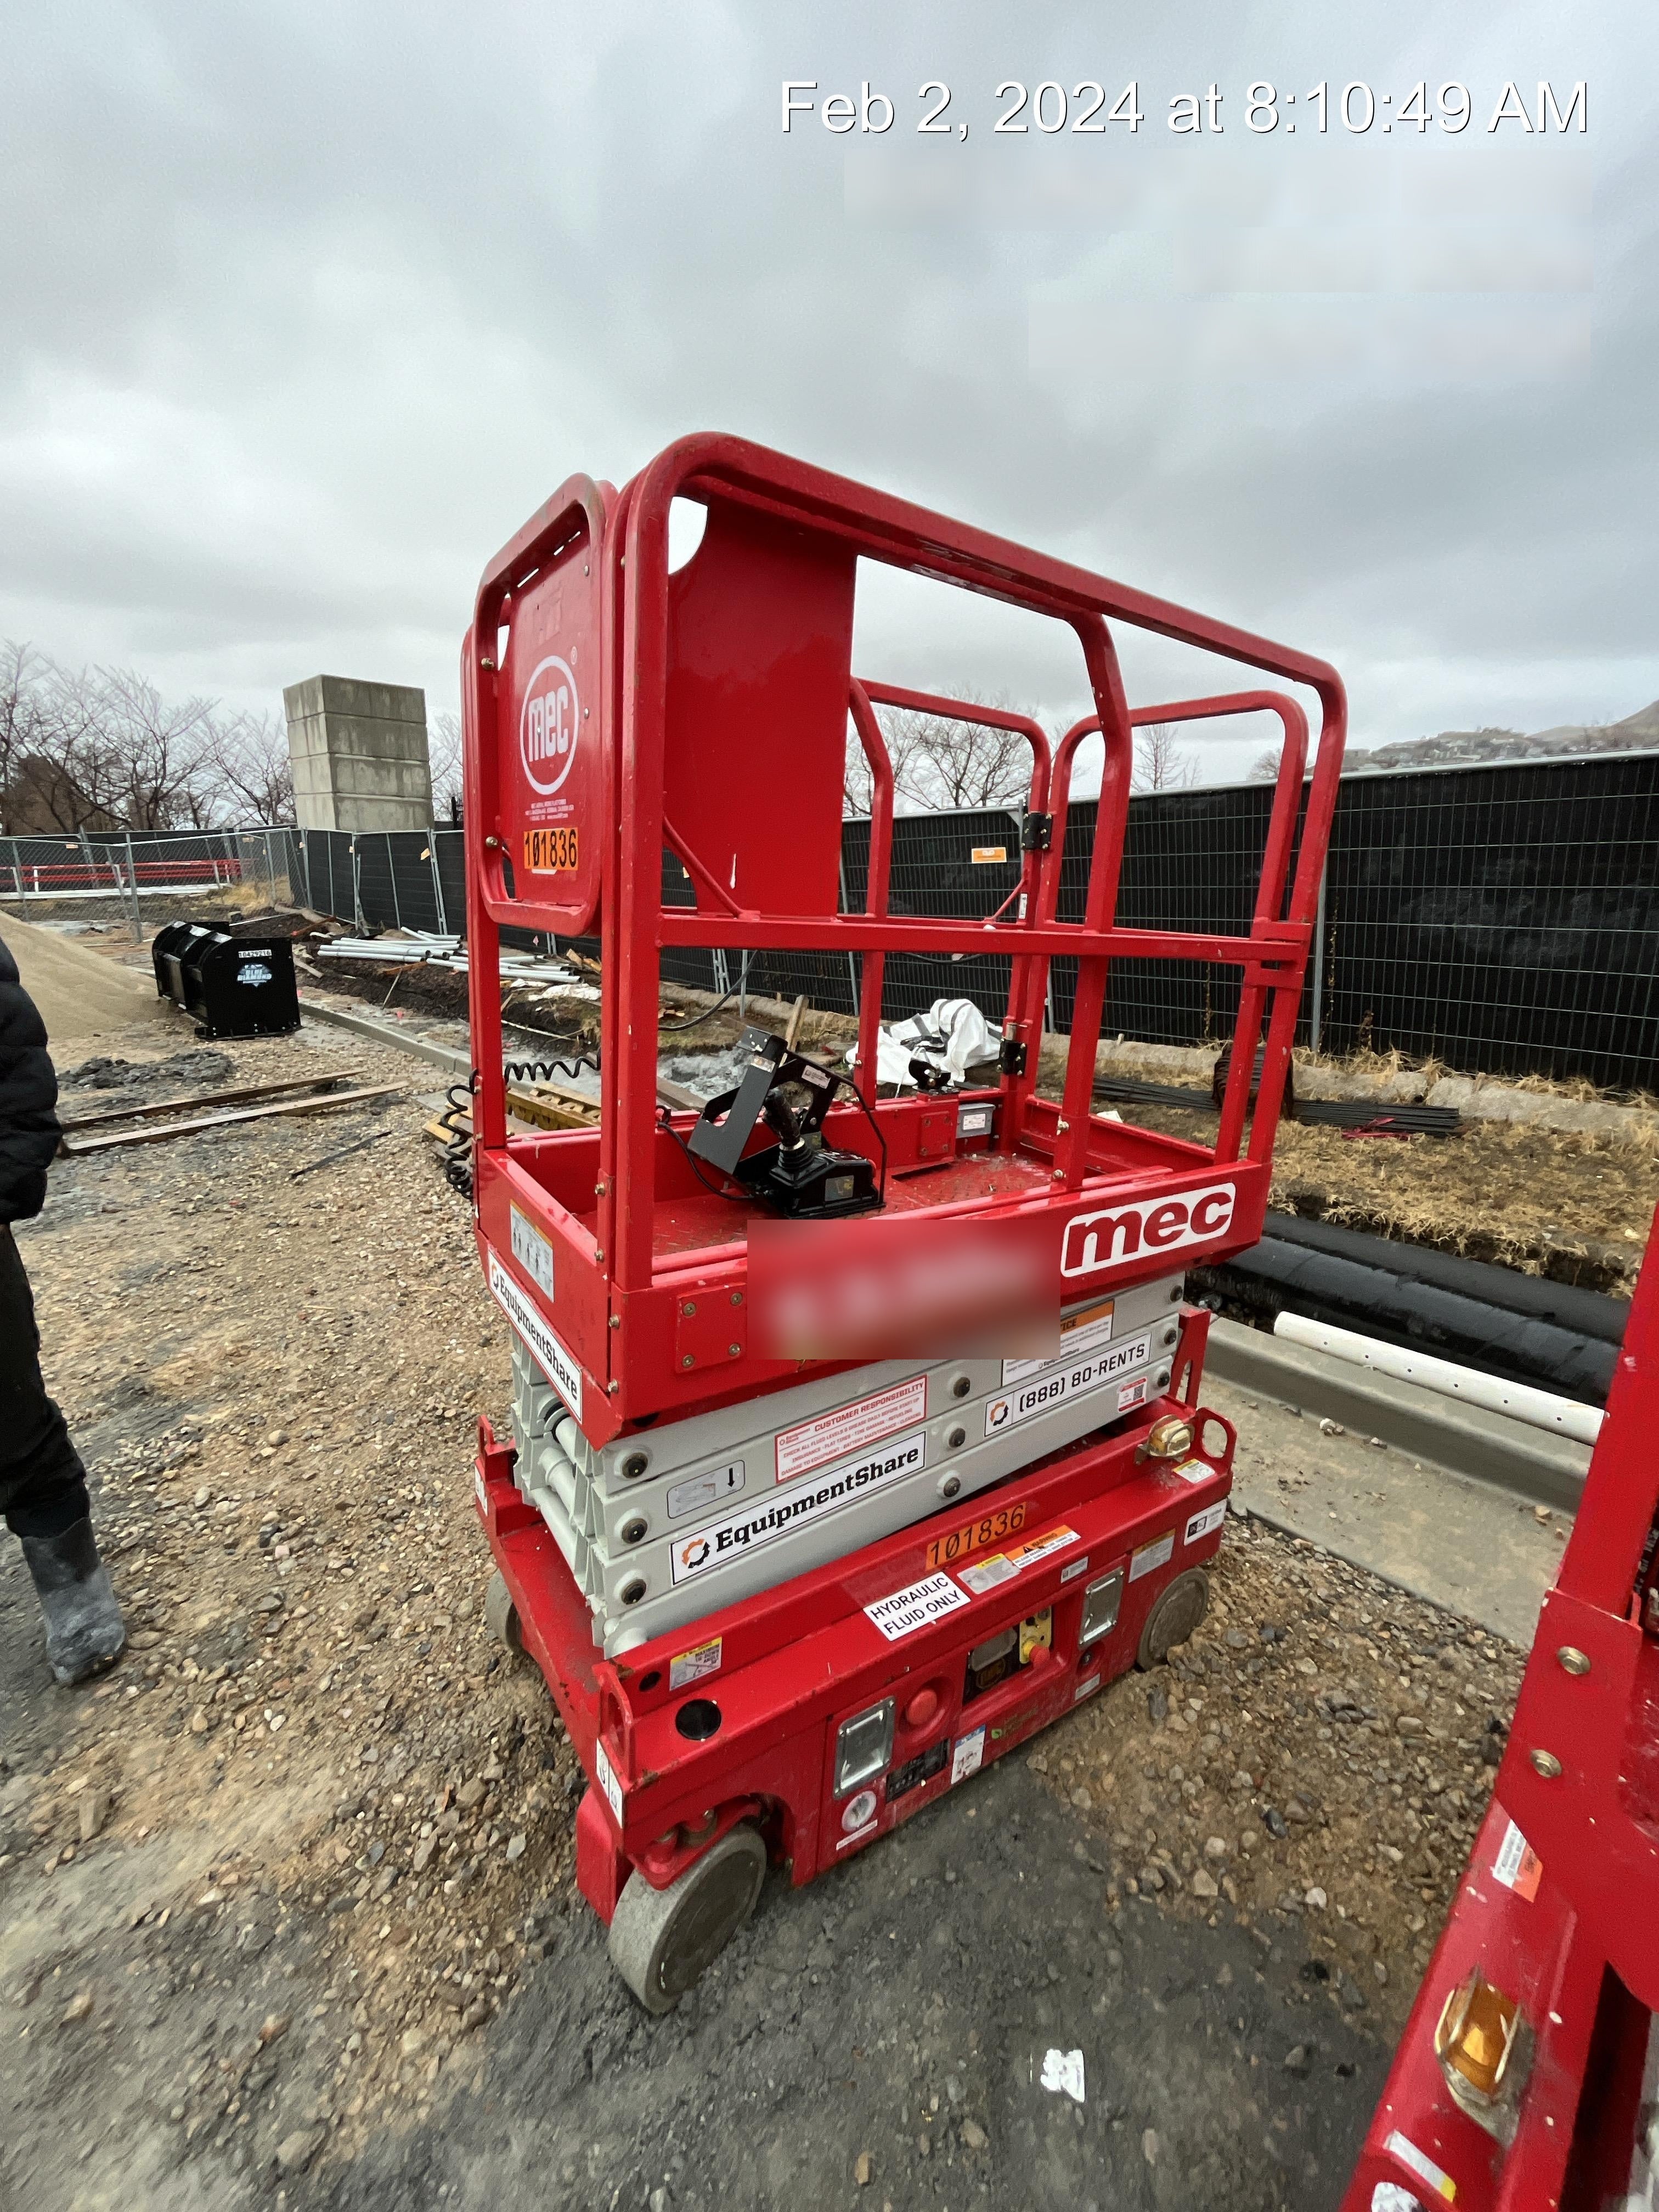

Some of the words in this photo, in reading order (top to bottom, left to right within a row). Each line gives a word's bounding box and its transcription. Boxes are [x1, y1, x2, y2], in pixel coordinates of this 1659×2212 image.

[524, 829, 577, 867] 101836
[500, 1274, 578, 1401] EquipmentShare
[1019, 1377, 1065, 1413] (888)
[1071, 1342, 1146, 1389] 80-RENTS
[815, 1408, 859, 1432] CUSTOMER
[861, 1382, 924, 1412] RESPONSIBILITY
[715, 1447, 918, 1553] EquipmentShare
[930, 1505, 1024, 1565] 101836
[870, 1576, 949, 1621] HYDRAULIC
[884, 1608, 925, 1635] FLUID
[929, 1590, 962, 1614] ONLY
